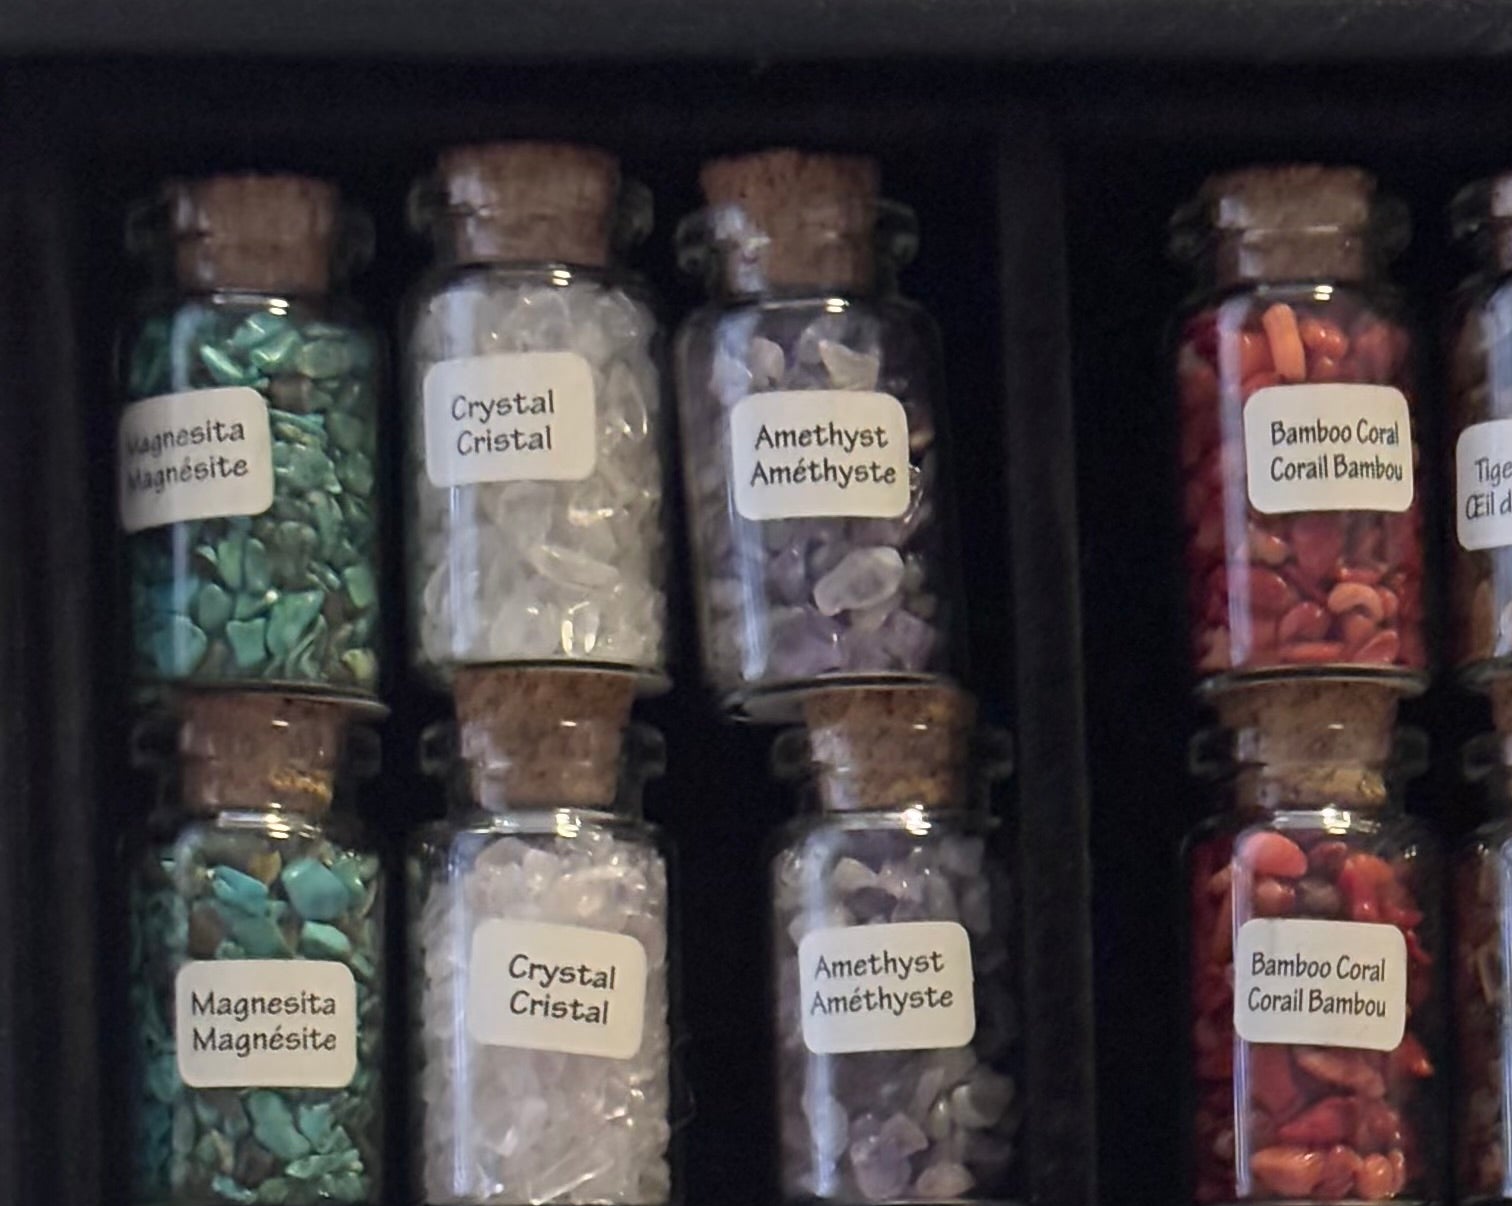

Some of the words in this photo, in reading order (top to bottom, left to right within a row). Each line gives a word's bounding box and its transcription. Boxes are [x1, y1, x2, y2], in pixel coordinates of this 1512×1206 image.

[451, 389, 555, 423] Crystal
[456, 425, 553, 453] Cristal
[754, 424, 888, 458] Amethyst
[1270, 422, 1352, 445] Bamboo
[1356, 421, 1399, 446] Coral
[750, 459, 897, 490] Améthyste
[1270, 455, 1329, 480] Corail
[1334, 455, 1403, 482] Bambou
[1465, 492, 1497, 518] Œil
[508, 954, 616, 991] Crystal
[814, 951, 944, 982] Amethyst
[1251, 952, 1332, 978] Bamboo
[1336, 956, 1385, 982] Coral
[190, 991, 337, 1020] Magnesita
[509, 990, 609, 1024] Cristal
[810, 986, 954, 1017] Améthyste
[1247, 987, 1303, 1013] Corail
[1308, 989, 1387, 1019] Bambou
[192, 1027, 337, 1054] Magnésite
